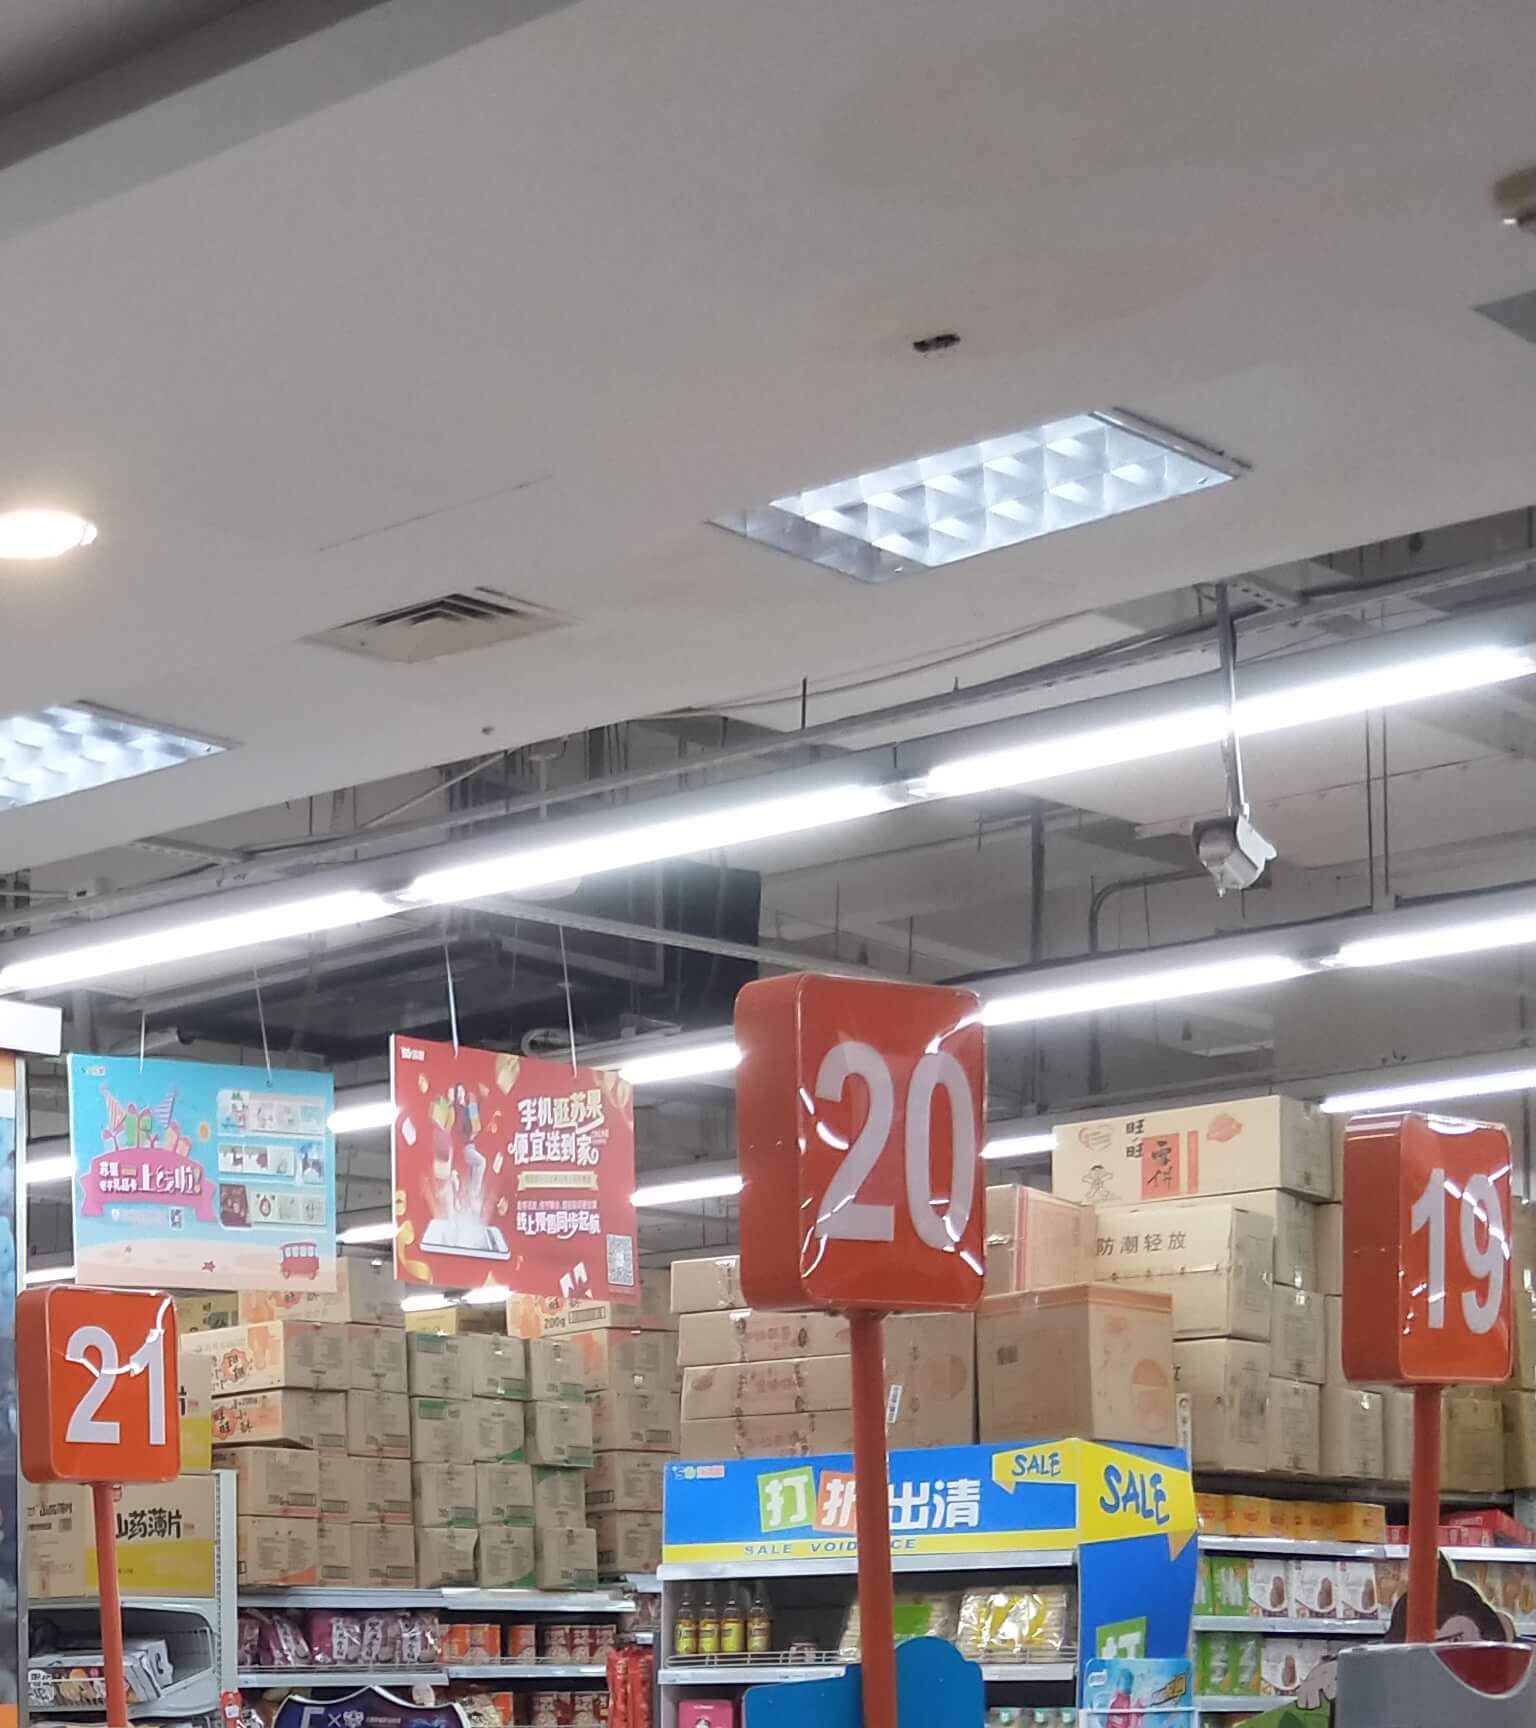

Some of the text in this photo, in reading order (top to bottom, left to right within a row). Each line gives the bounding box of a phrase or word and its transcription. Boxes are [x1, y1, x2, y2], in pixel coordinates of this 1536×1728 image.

[509, 1130, 599, 1166] 便宜送到家
[814, 1040, 976, 1251] 20
[1096, 1231, 1187, 1257] 防潮轻放
[1410, 1168, 1504, 1336] 19
[65, 1322, 167, 1445] 21
[1012, 1452, 1061, 1477] SALE
[1100, 1464, 1171, 1526] SALE
[745, 1543, 793, 1556] SALE
